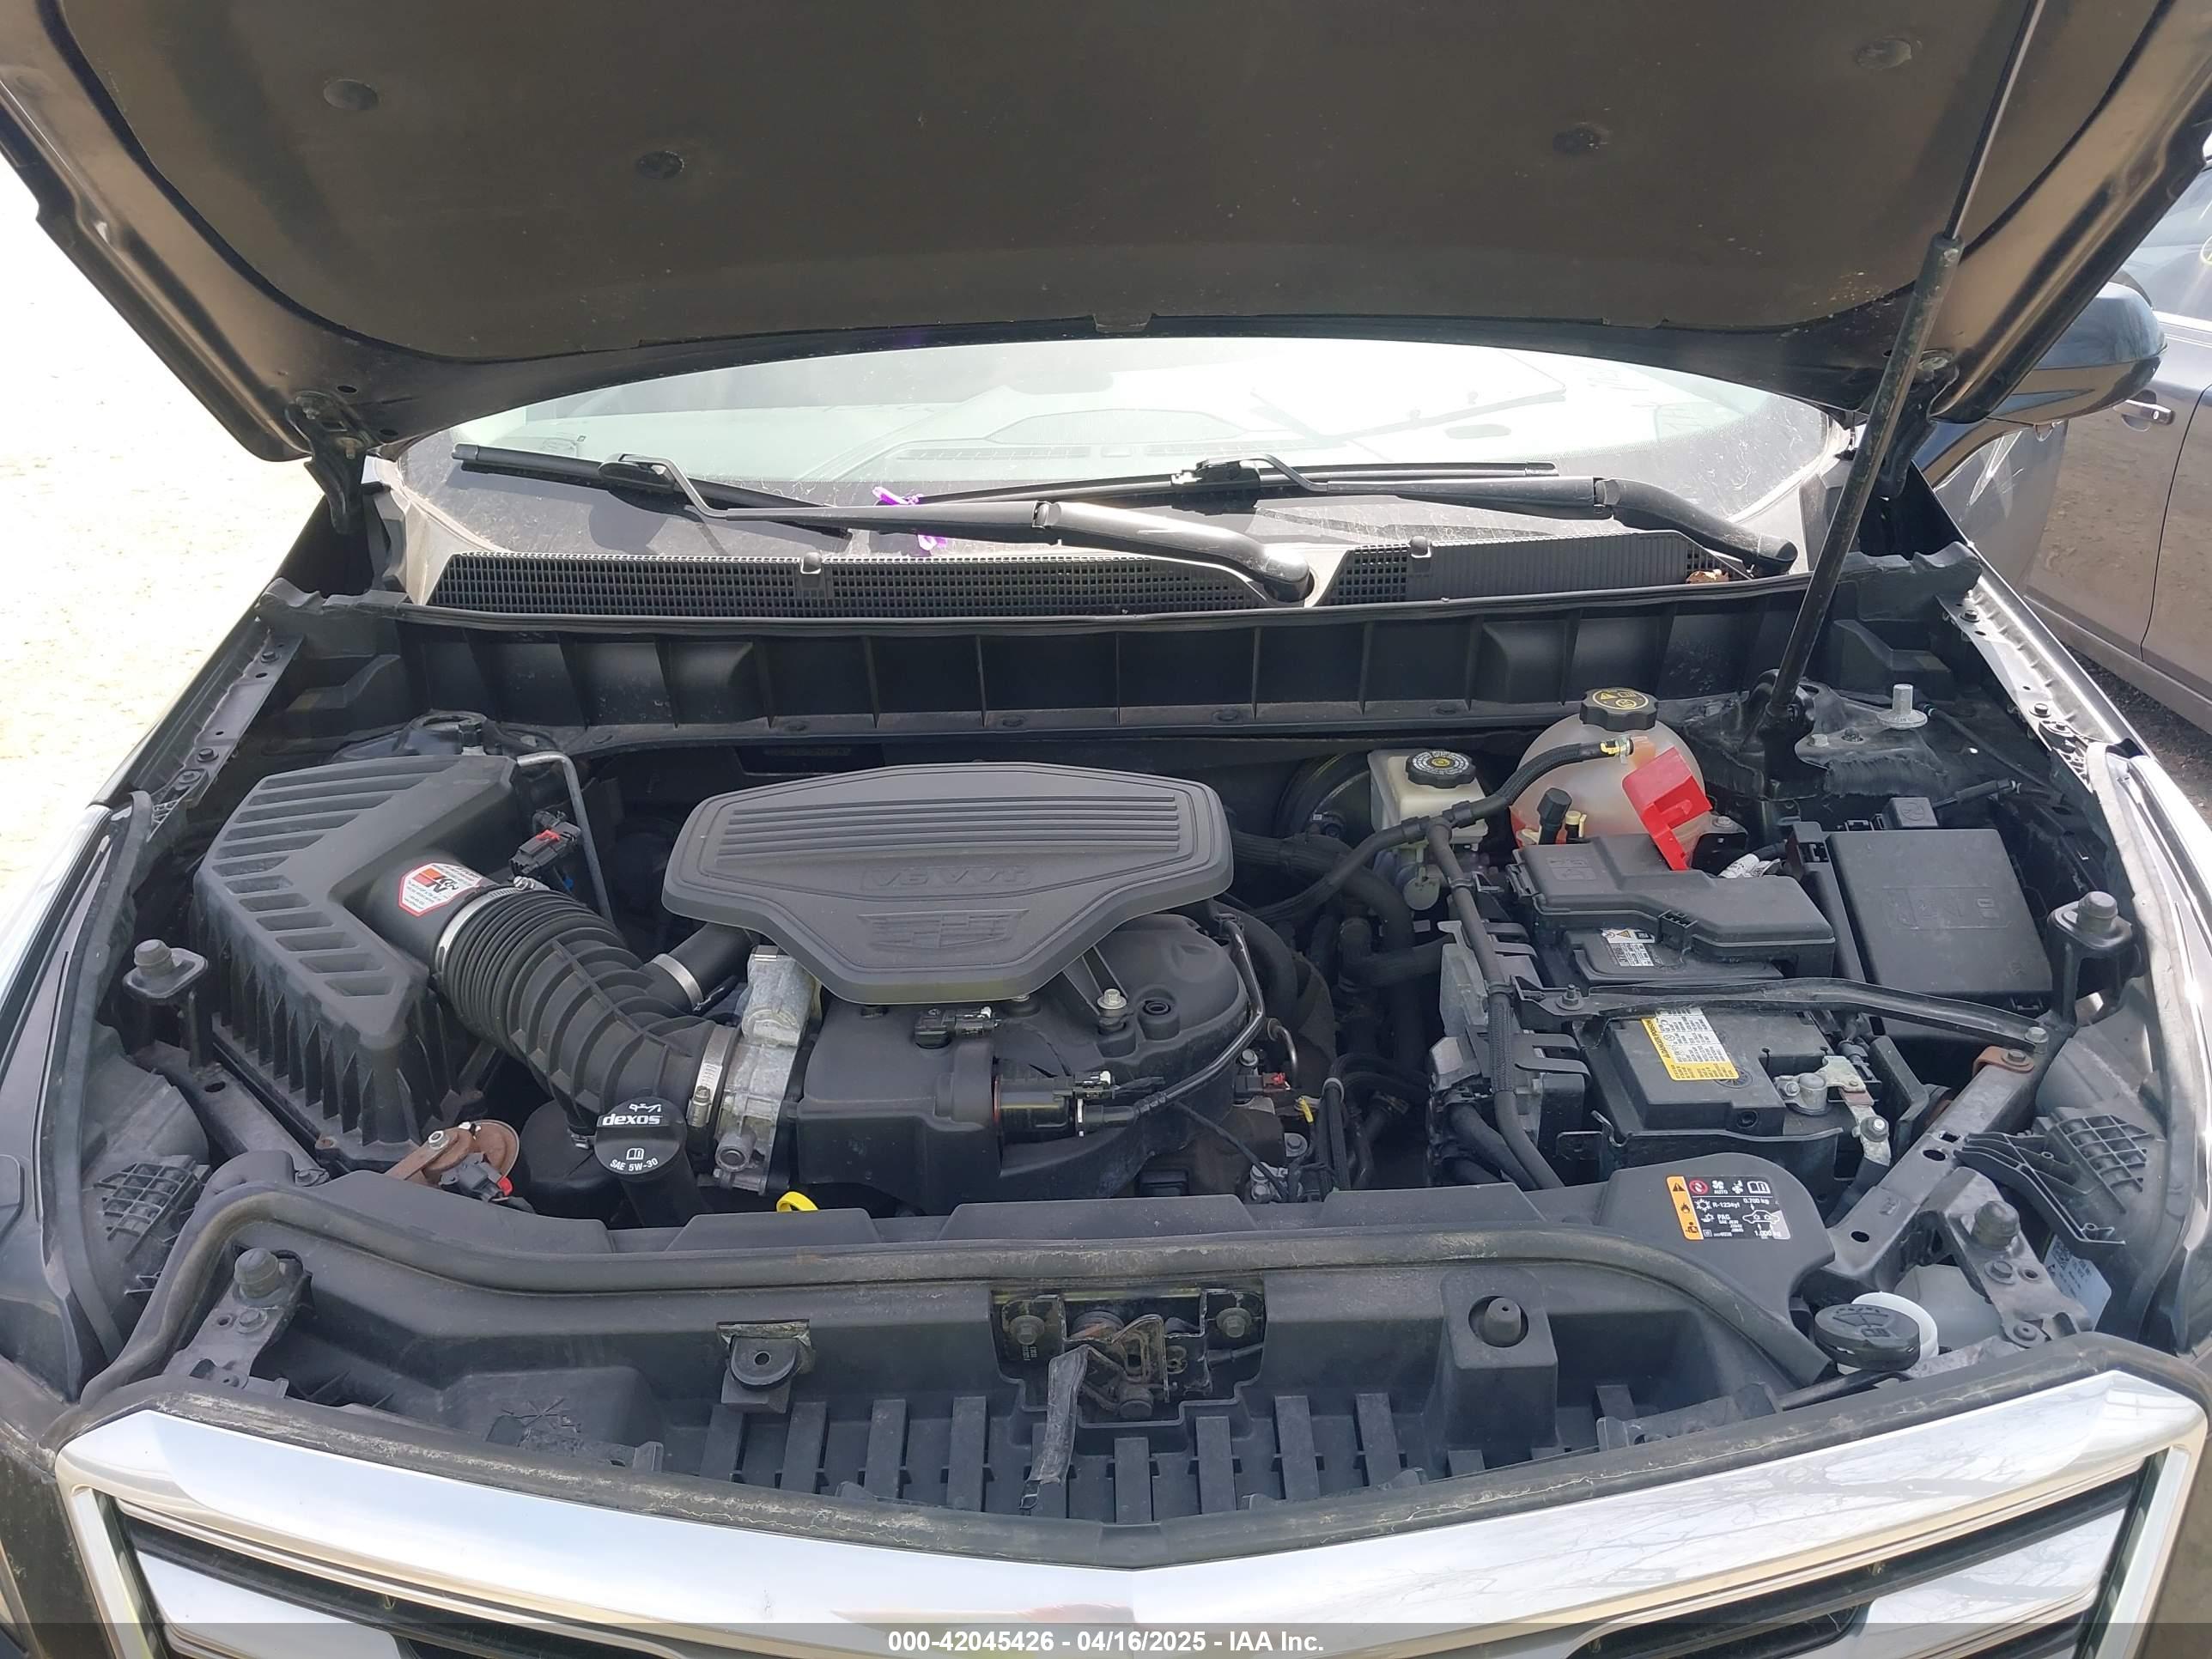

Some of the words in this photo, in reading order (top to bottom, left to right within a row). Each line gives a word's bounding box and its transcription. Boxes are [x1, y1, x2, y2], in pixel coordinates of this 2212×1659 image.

[602, 1113, 663, 1126] dexos
[610, 1159, 626, 1170] SAE
[629, 1158, 659, 1171] 5W-30
